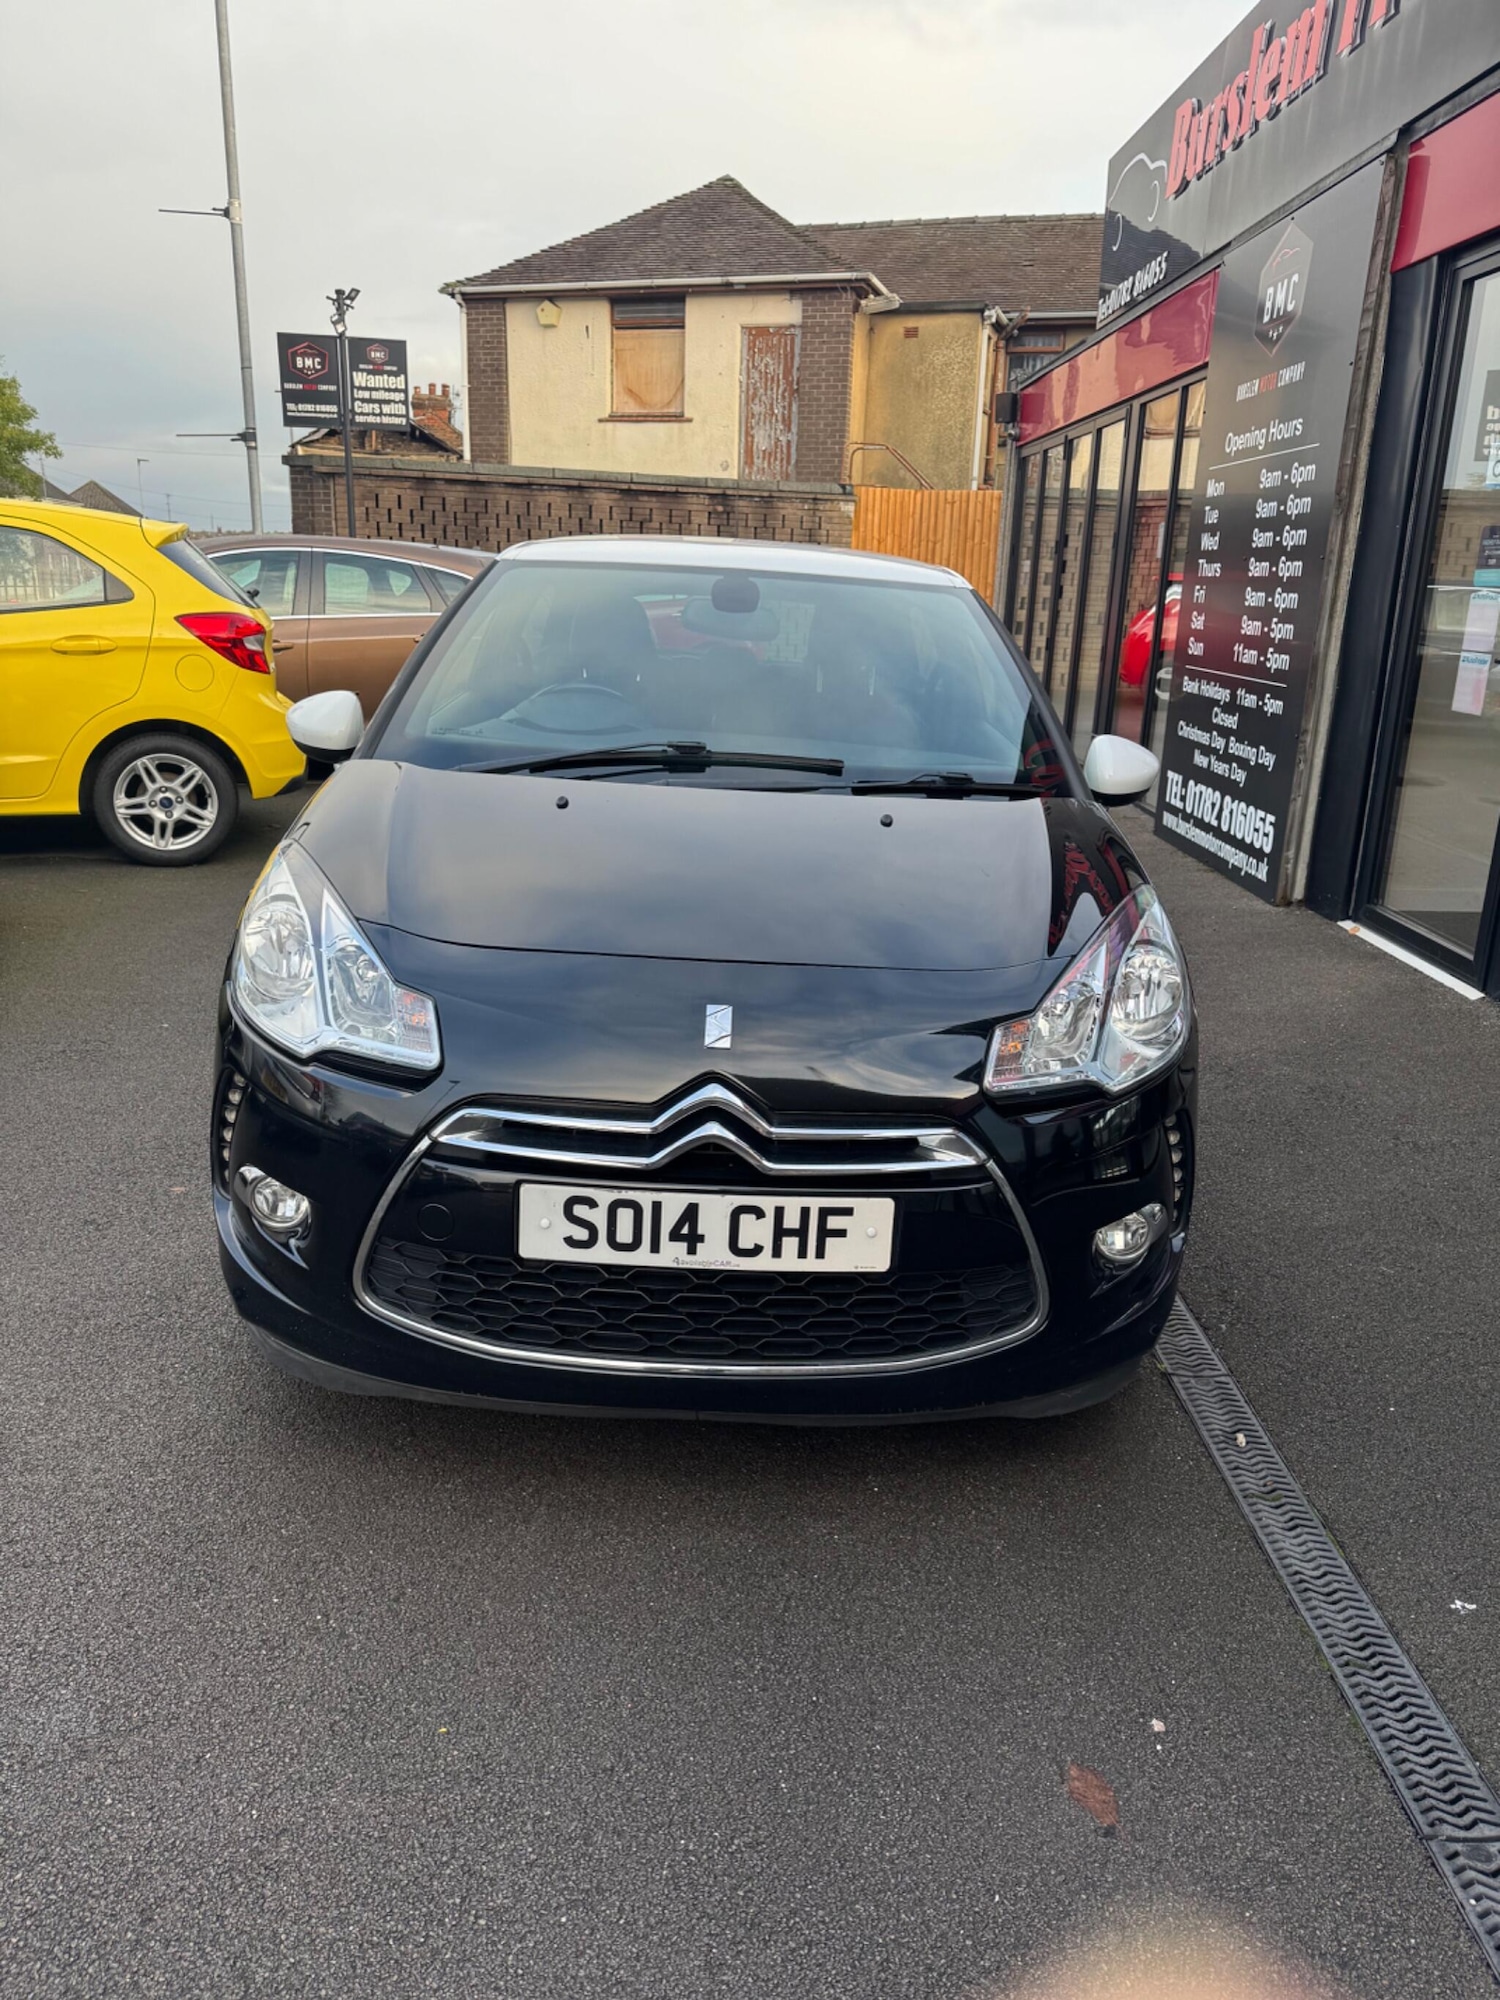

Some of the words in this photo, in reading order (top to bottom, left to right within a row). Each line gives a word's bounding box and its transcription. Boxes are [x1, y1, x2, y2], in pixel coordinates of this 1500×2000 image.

[1165, 0, 1331, 200] Burslem
[1133, 250, 1168, 297] 816055
[1262, 273, 1299, 324] BMC
[296, 357, 321, 369] BMC
[1278, 361, 1306, 387] COMPANY
[352, 372, 405, 389] Wanted
[354, 388, 370, 398] Low
[371, 390, 405, 401] mileage
[354, 400, 380, 414] Cars
[381, 402, 406, 414] with
[355, 414, 380, 423] service
[382, 414, 406, 425] history
[1225, 425, 1266, 456] Opening
[1268, 417, 1304, 443] Hours
[1206, 479, 1224, 498] Mon
[1259, 468, 1281, 489] 9am
[1290, 462, 1316, 488] 6pm
[1204, 506, 1219, 525] Tue
[1255, 499, 1277, 519] 9am
[1286, 494, 1312, 520] 6pm
[1200, 532, 1220, 551] Wed
[1252, 528, 1273, 548] 9am
[1282, 525, 1307, 551] 6pm
[1198, 559, 1222, 578] Thurs
[1248, 557, 1270, 578] 9am
[1278, 556, 1303, 582] 6pm
[1194, 586, 1206, 604] Fri
[1244, 587, 1266, 607] 9am
[1274, 587, 1299, 613] 6pm
[1190, 611, 1204, 630] Sat
[1240, 616, 1262, 636] 9am
[1270, 618, 1294, 644] 5pm
[1188, 637, 1204, 656] Sun
[1233, 643, 1258, 665] 11am
[1266, 649, 1290, 674] 5pm
[1182, 676, 1200, 694] Bank
[1200, 680, 1230, 706] Holidays
[1236, 687, 1258, 708] 11am
[1263, 693, 1284, 716] 5pm
[1212, 706, 1239, 730] Closed
[1178, 720, 1210, 746] Christmas
[1211, 730, 1226, 754] Day
[1228, 736, 1257, 766] Boxing
[1258, 745, 1276, 772] Day
[1193, 749, 1210, 769] New
[1210, 754, 1230, 778] Years
[1230, 762, 1248, 788] Day
[1165, 770, 1184, 810] TEL:
[1186, 780, 1220, 828] 01782
[1221, 796, 1276, 854] 816055
[562, 1195, 705, 1256] SO14
[728, 1205, 854, 1260] CHF
